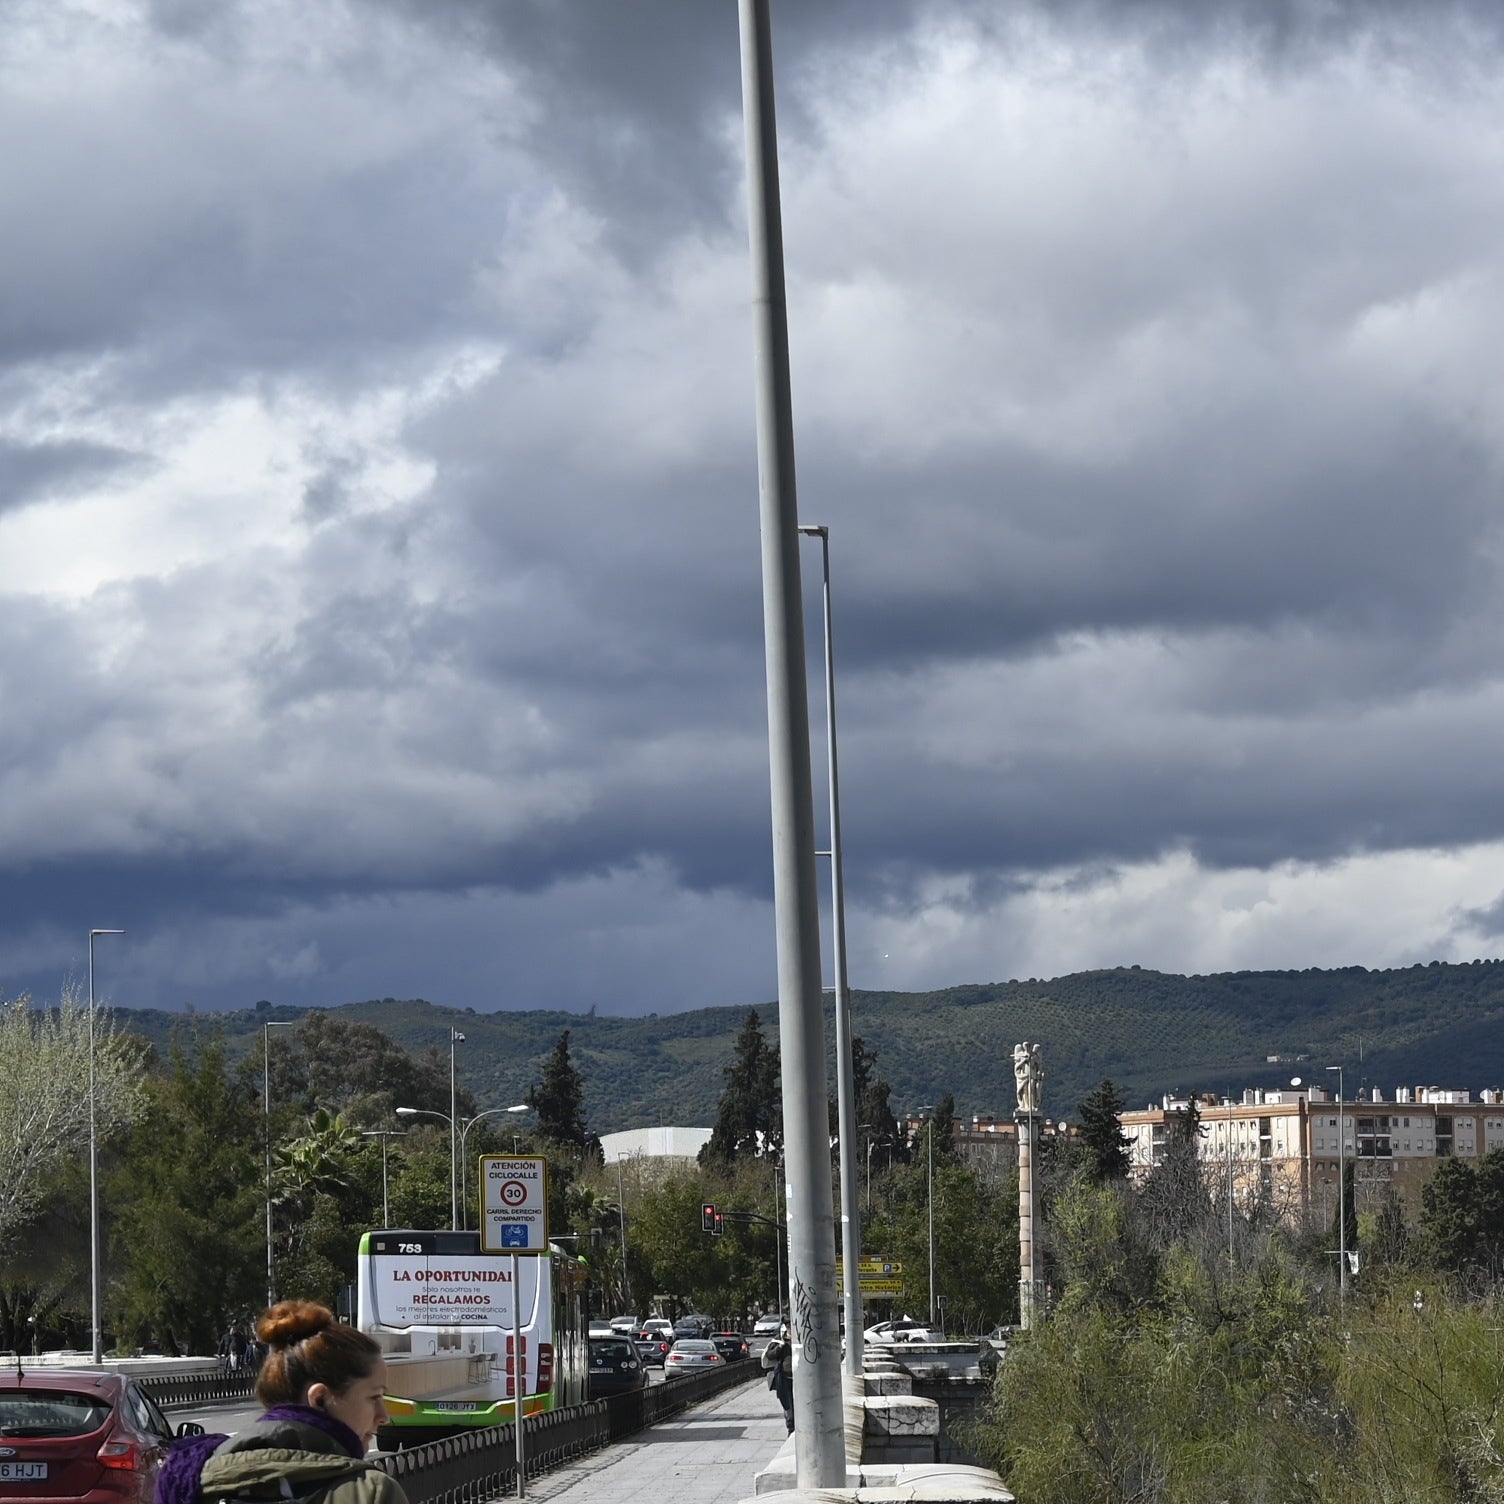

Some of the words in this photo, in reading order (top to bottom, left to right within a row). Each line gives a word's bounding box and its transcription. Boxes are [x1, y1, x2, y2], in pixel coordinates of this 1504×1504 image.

[491, 1161, 536, 1170] ATENCIÓN
[506, 1189, 521, 1198] 30
[398, 1243, 422, 1253] 753
[393, 1270, 412, 1281] LA
[413, 1295, 491, 1305] REGALAMOS
[408, 1305, 438, 1314] mejores
[440, 1305, 507, 1313] electrodomésticos
[15, 1464, 44, 1477] HJT
